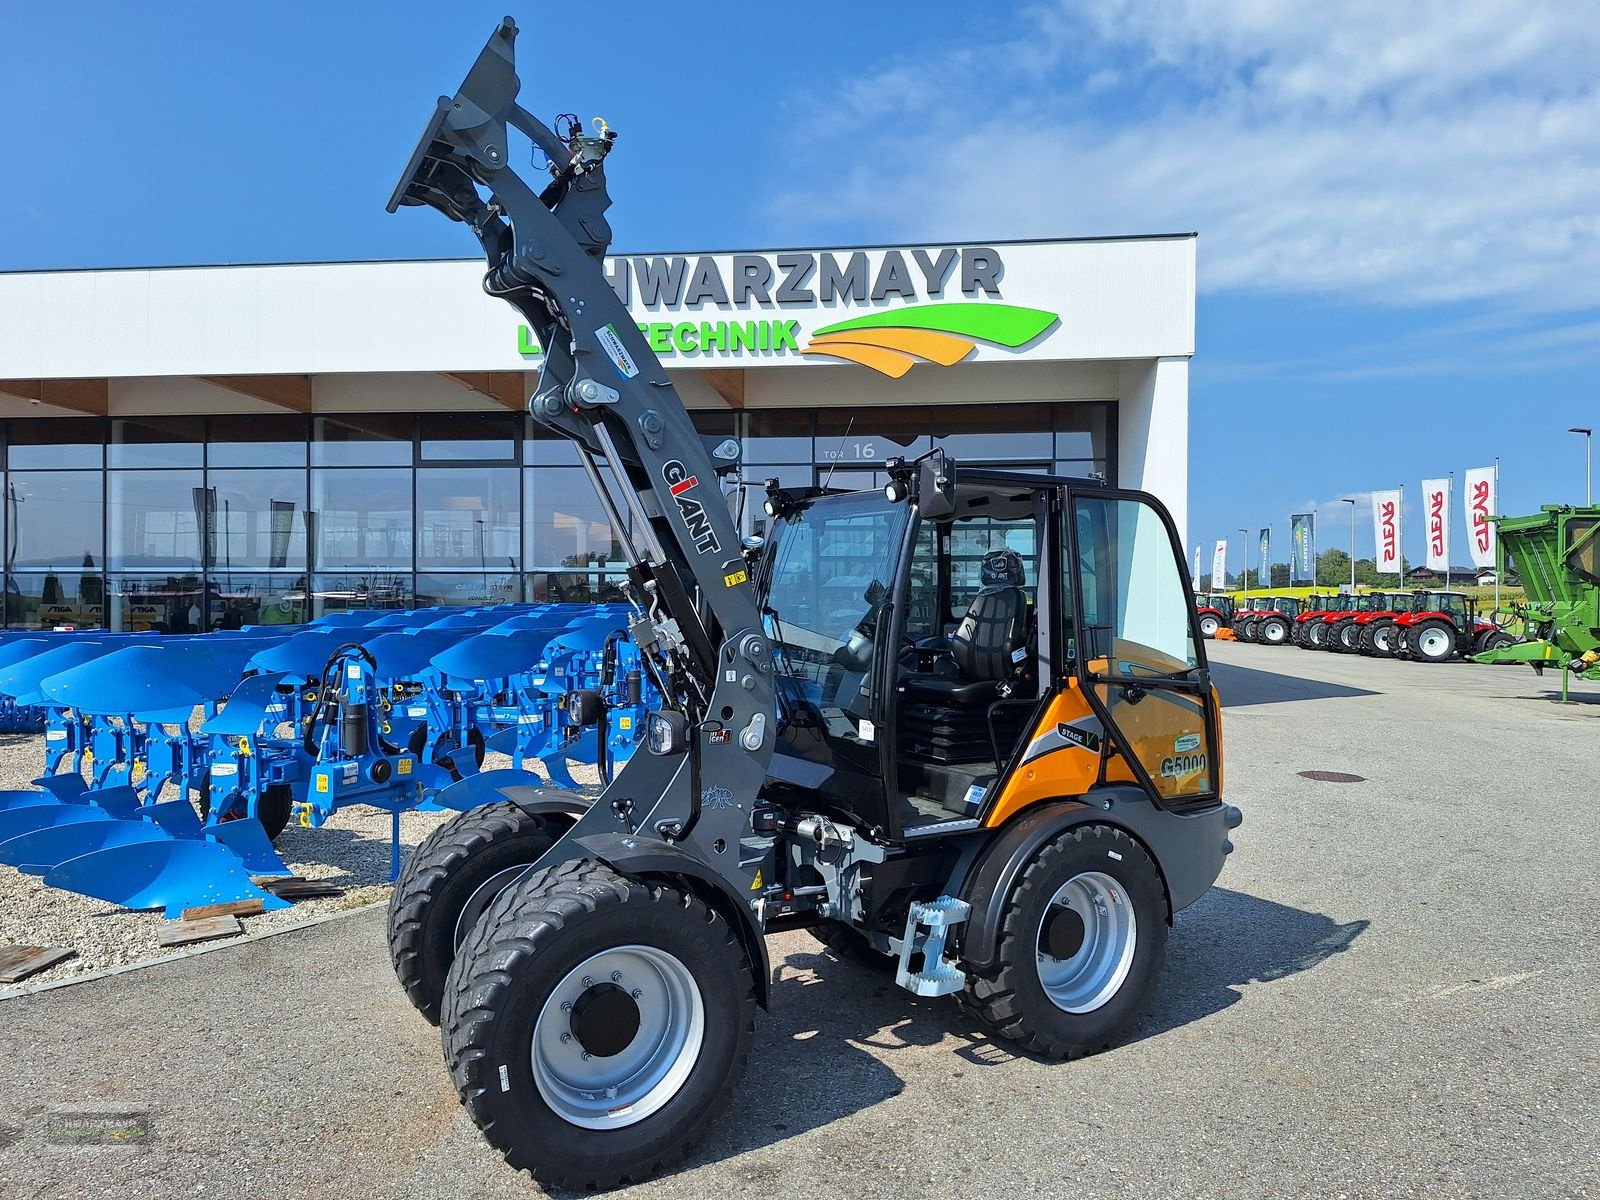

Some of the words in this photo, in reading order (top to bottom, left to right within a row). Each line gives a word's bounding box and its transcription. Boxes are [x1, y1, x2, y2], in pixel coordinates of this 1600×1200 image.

[603, 247, 1001, 305] HWARZMAYR
[823, 450, 844, 459] TOR
[853, 442, 876, 459] 16
[1061, 728, 1084, 743] STAGE
[1160, 752, 1206, 778] G5000
